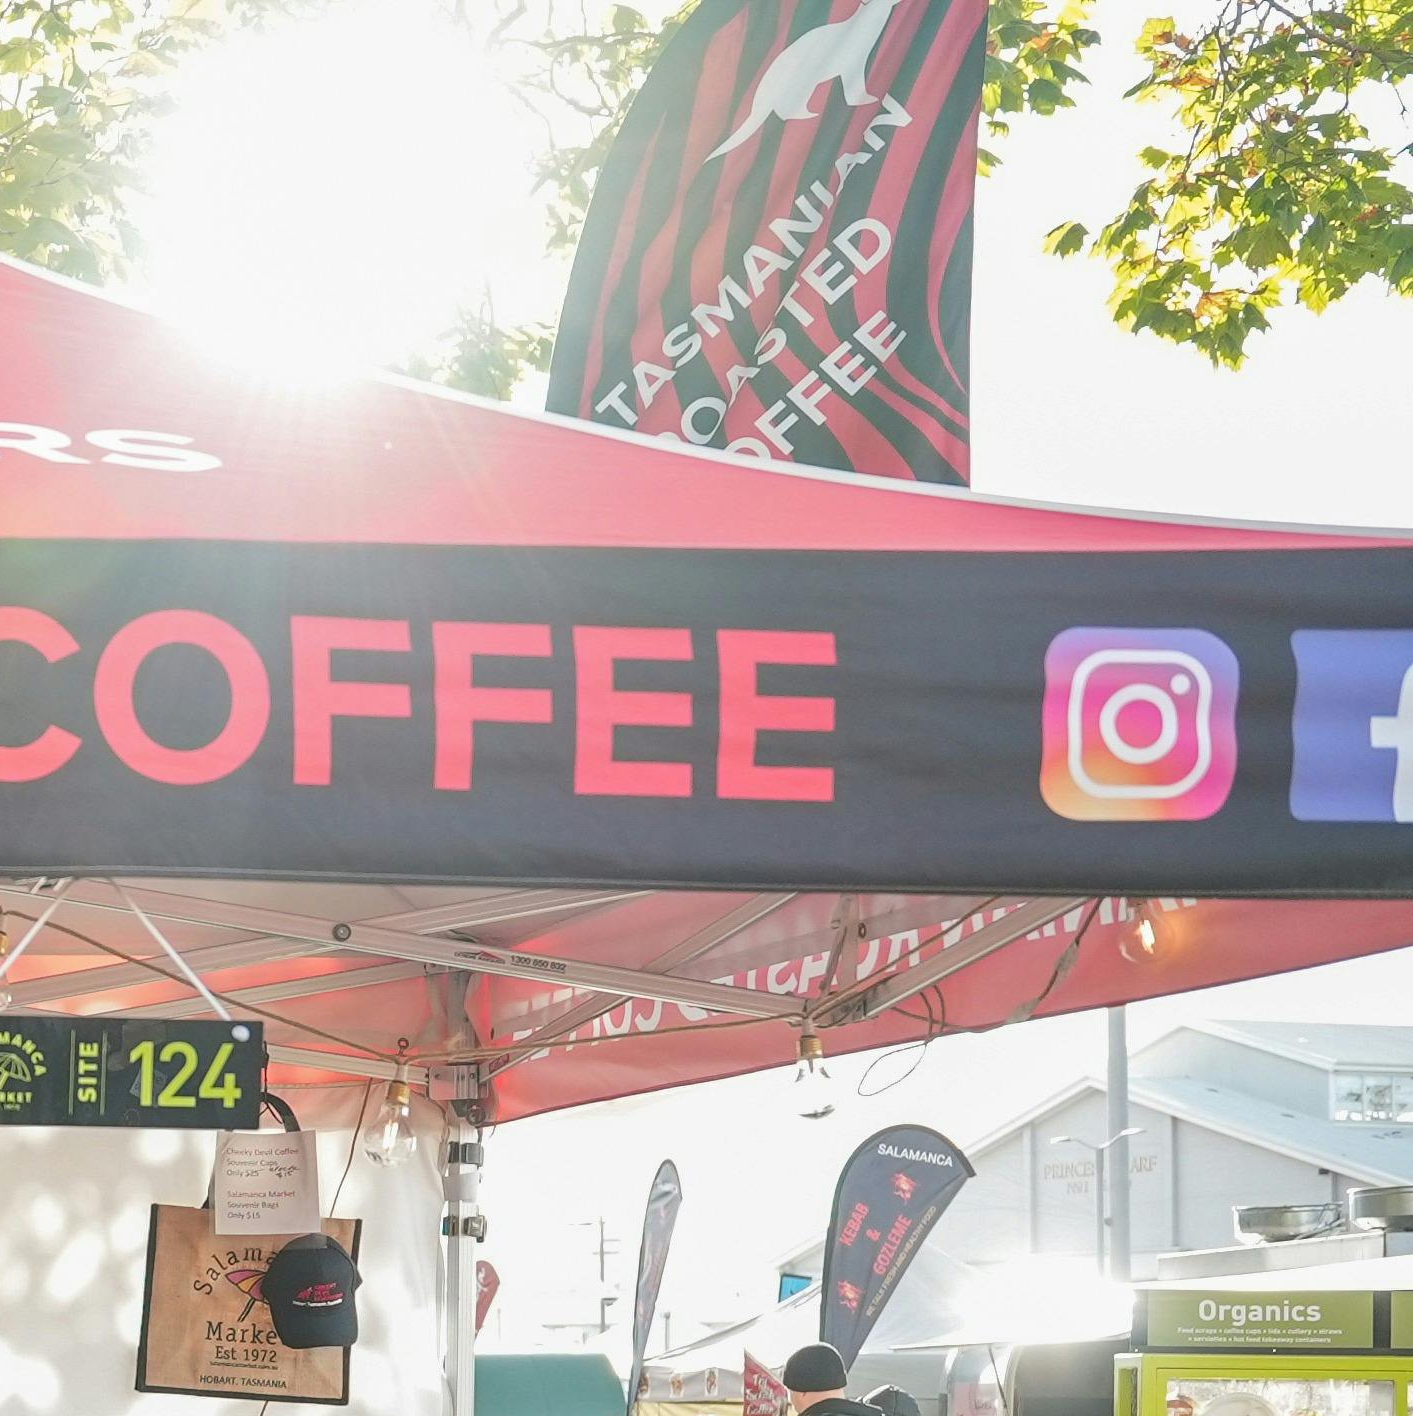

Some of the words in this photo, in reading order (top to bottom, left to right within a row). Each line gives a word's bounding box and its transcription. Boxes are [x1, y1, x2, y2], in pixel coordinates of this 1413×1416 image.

[594, 92, 913, 427] TASMANIAN
[653, 217, 893, 446] OASTED
[77, 1042, 100, 1102] SITE
[128, 1040, 243, 1110] 124
[877, 1143, 953, 1168] SALAMANCA
[839, 1202, 869, 1247] KEBAB
[866, 1228, 881, 1242] &
[873, 1213, 913, 1276] GOZLEME
[205, 1320, 278, 1345] Marke
[1198, 1298, 1322, 1325] Organics
[215, 1345, 237, 1361] Est
[244, 1350, 278, 1363] 1972
